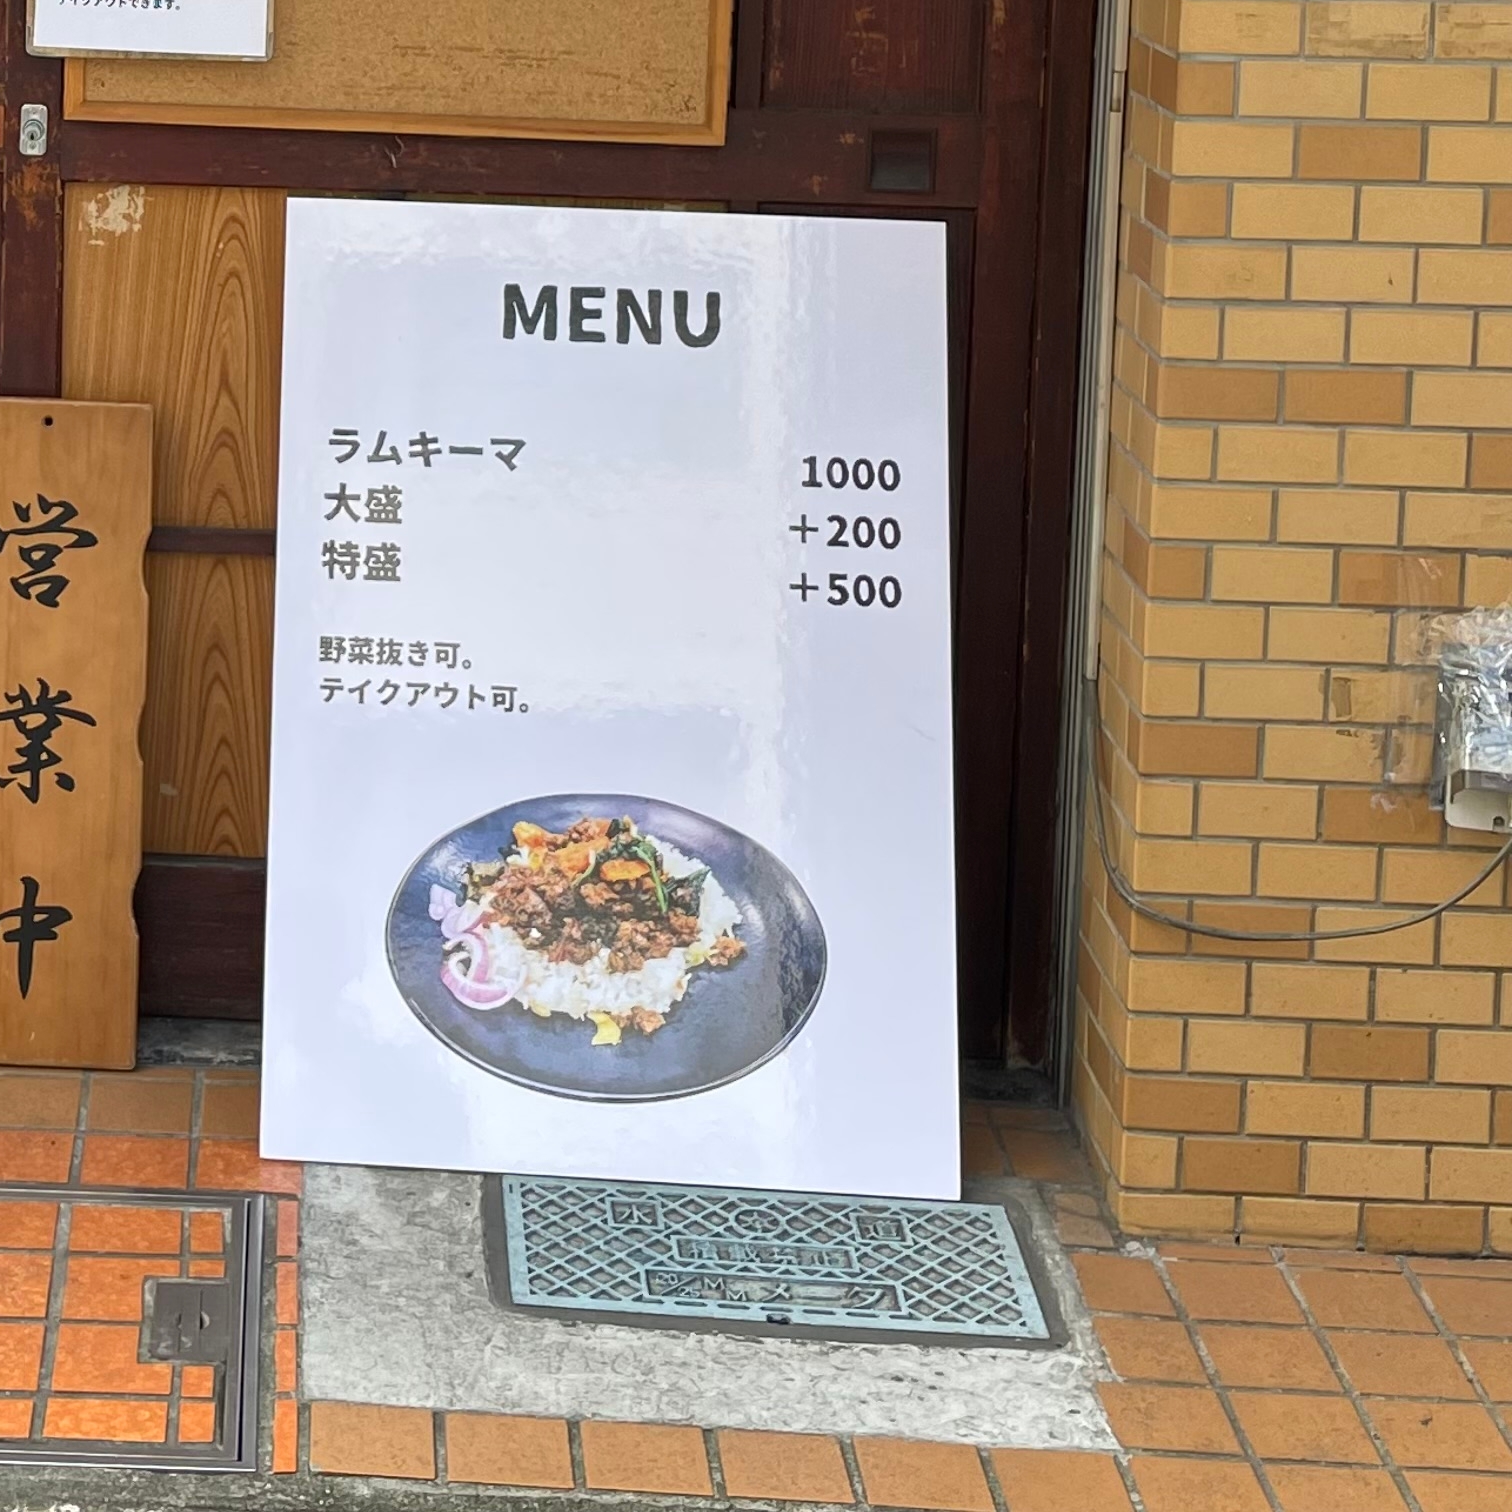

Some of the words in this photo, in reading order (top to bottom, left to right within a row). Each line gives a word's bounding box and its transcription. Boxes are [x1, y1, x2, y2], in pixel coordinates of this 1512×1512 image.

[502, 283, 721, 349] MENU
[328, 428, 527, 472] ラムキーマ
[801, 455, 901, 492] 1000
[323, 482, 403, 525] 大盛
[789, 513, 902, 550] +200
[321, 539, 401, 582] 特盛
[789, 572, 902, 609] +500
[318, 635, 472, 670] 野菜抜き可。
[319, 677, 529, 714] テイクアウト可。
[619, 1202, 653, 1225] 水
